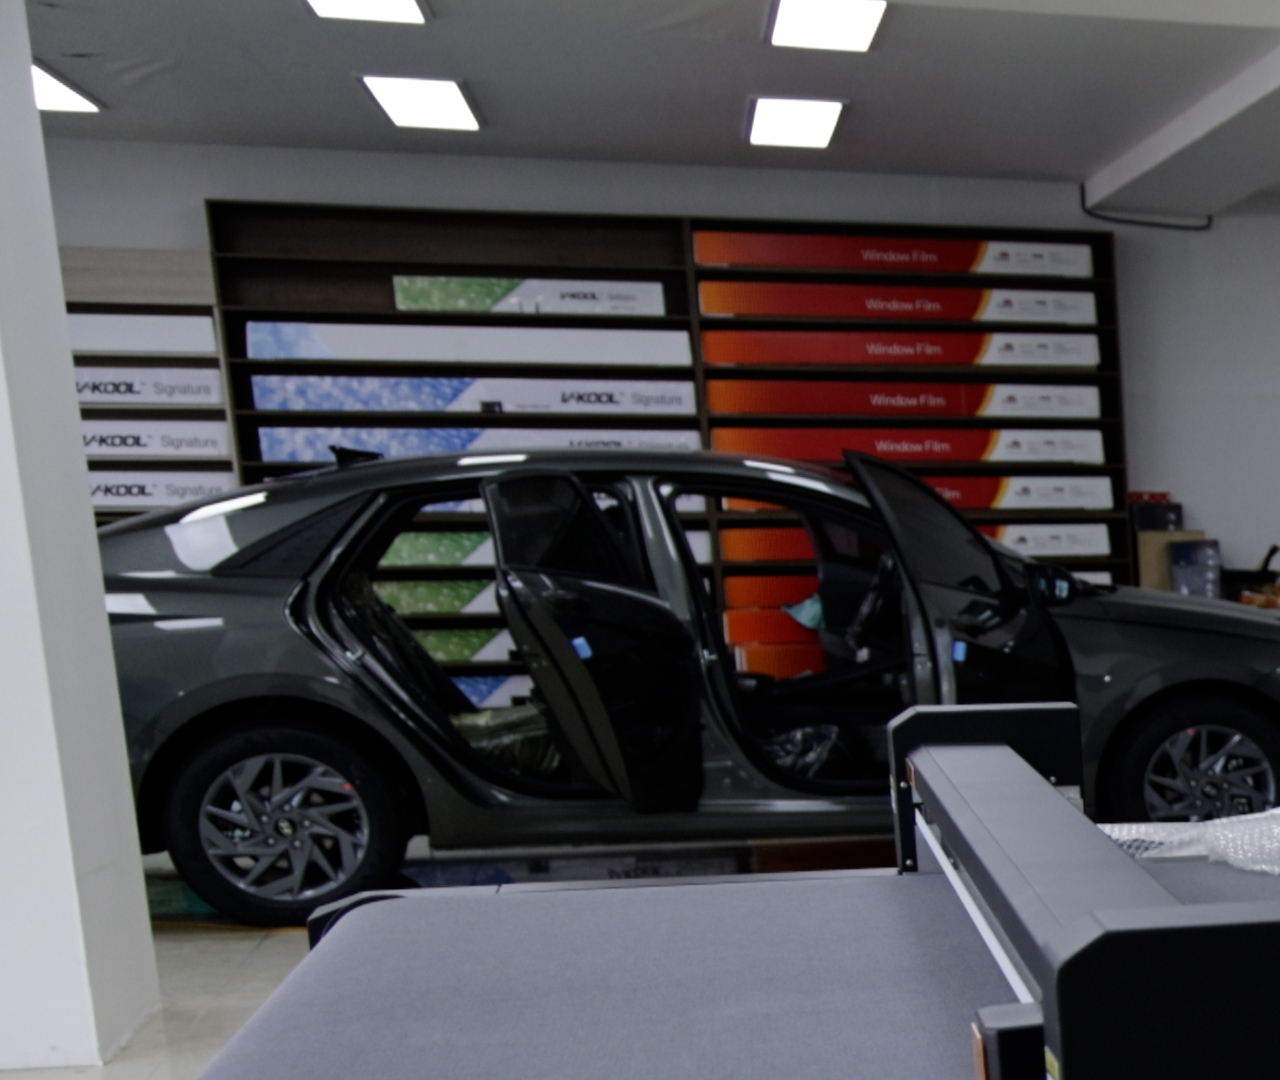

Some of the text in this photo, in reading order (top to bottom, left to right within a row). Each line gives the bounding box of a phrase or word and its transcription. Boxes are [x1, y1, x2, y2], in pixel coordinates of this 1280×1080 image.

[861, 249, 938, 263] Window Film
[865, 298, 942, 312] Window Film
[866, 342, 943, 356] Window Film
[153, 383, 211, 397] Signature
[561, 391, 683, 407] V-KOOL Signature
[870, 393, 945, 407] Window Film
[83, 434, 218, 451] V-KOOL Signature
[874, 440, 951, 453] Window Film
